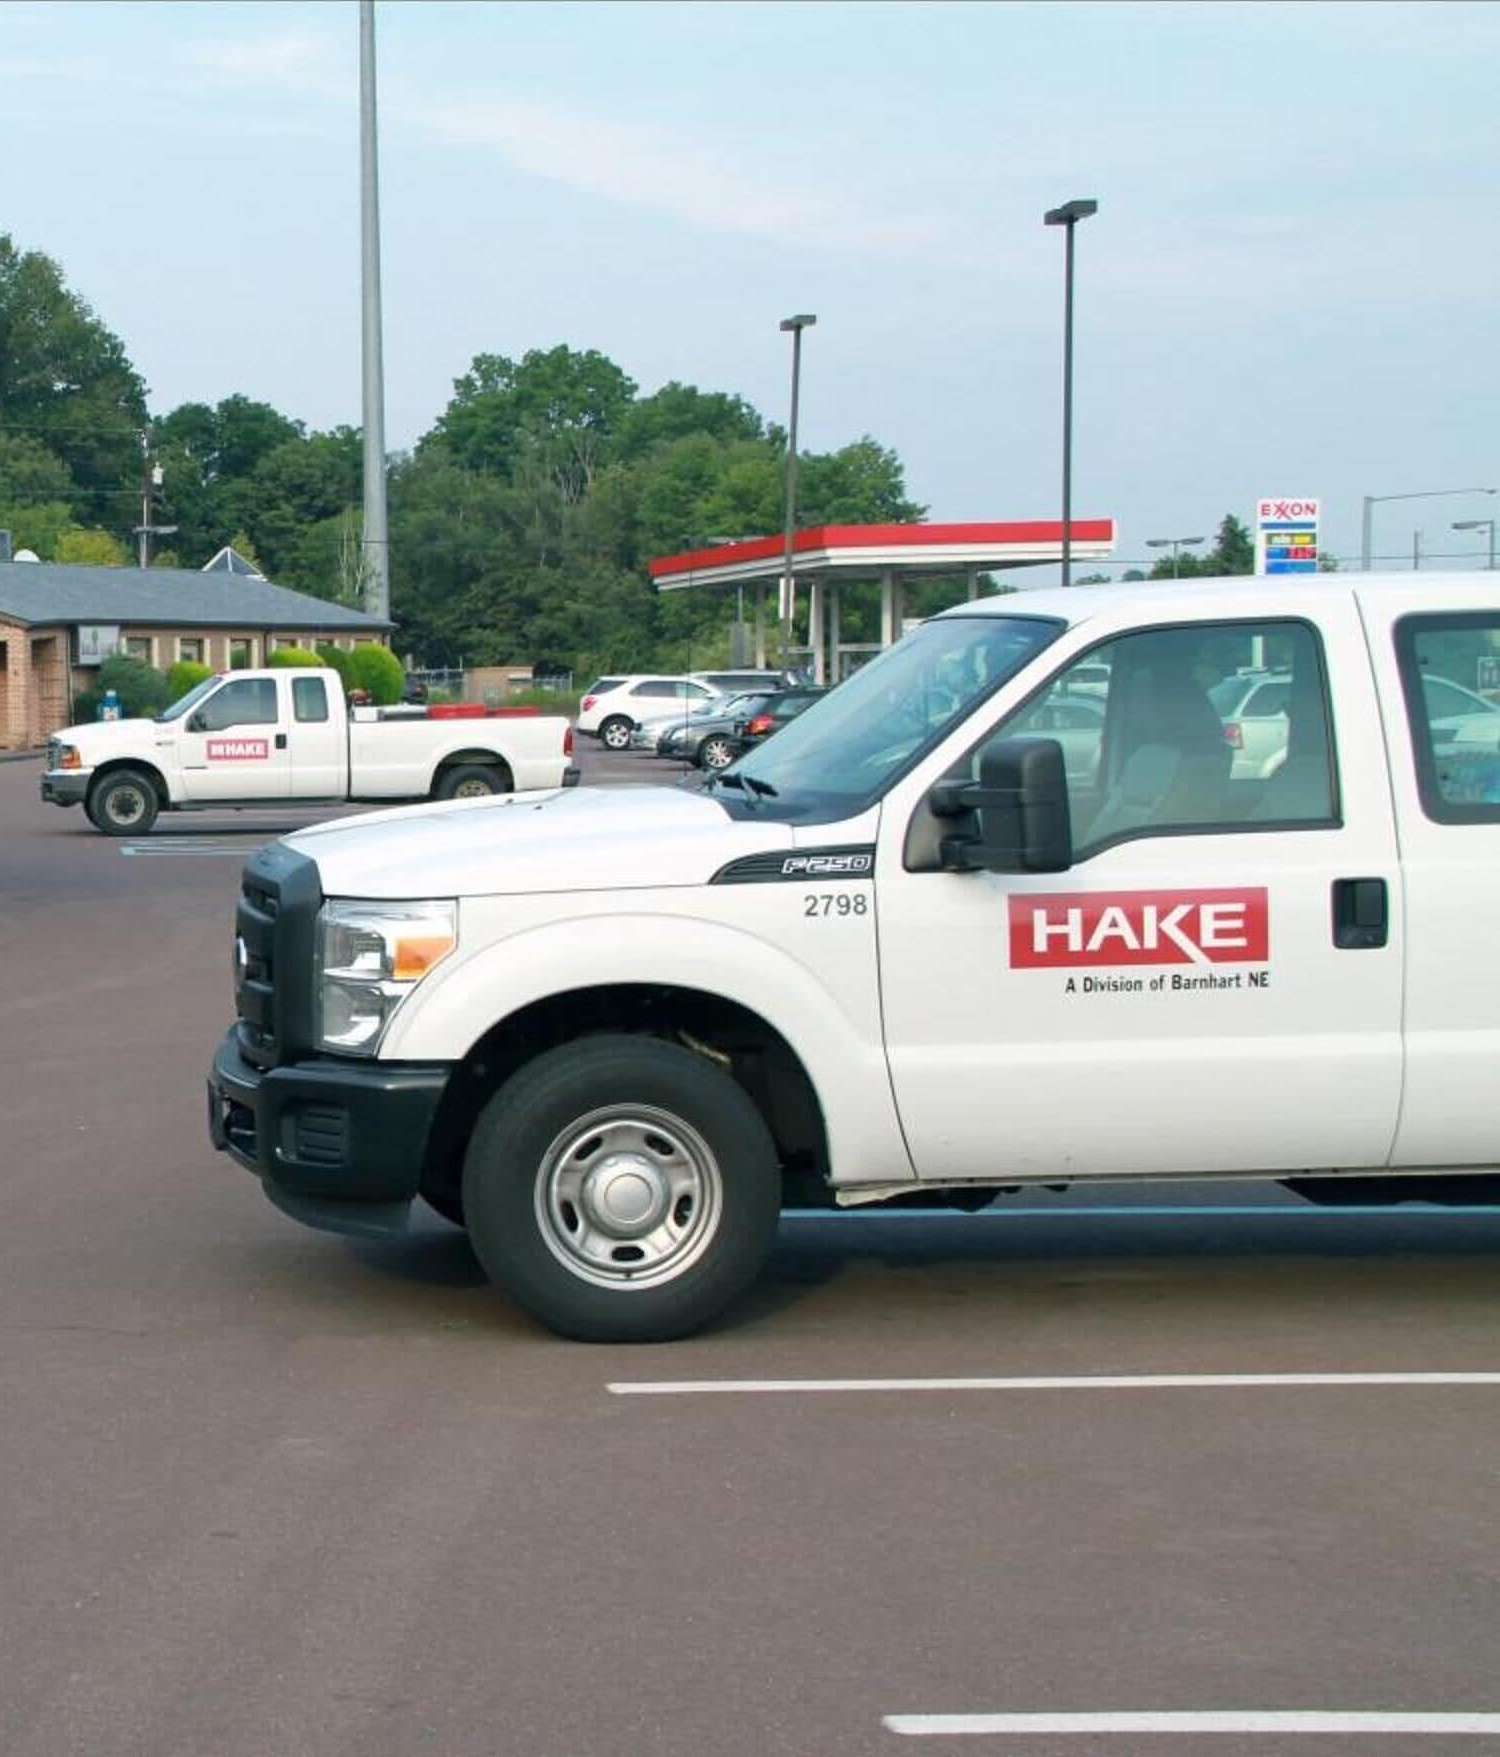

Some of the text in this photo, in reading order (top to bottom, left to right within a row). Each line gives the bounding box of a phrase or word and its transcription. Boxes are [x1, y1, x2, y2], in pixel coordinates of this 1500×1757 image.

[1261, 502, 1316, 520] EXXON
[804, 894, 867, 916] 2798
[1033, 902, 1248, 963] HAKE
[1065, 971, 1269, 993] A Division of Barnhart NE
